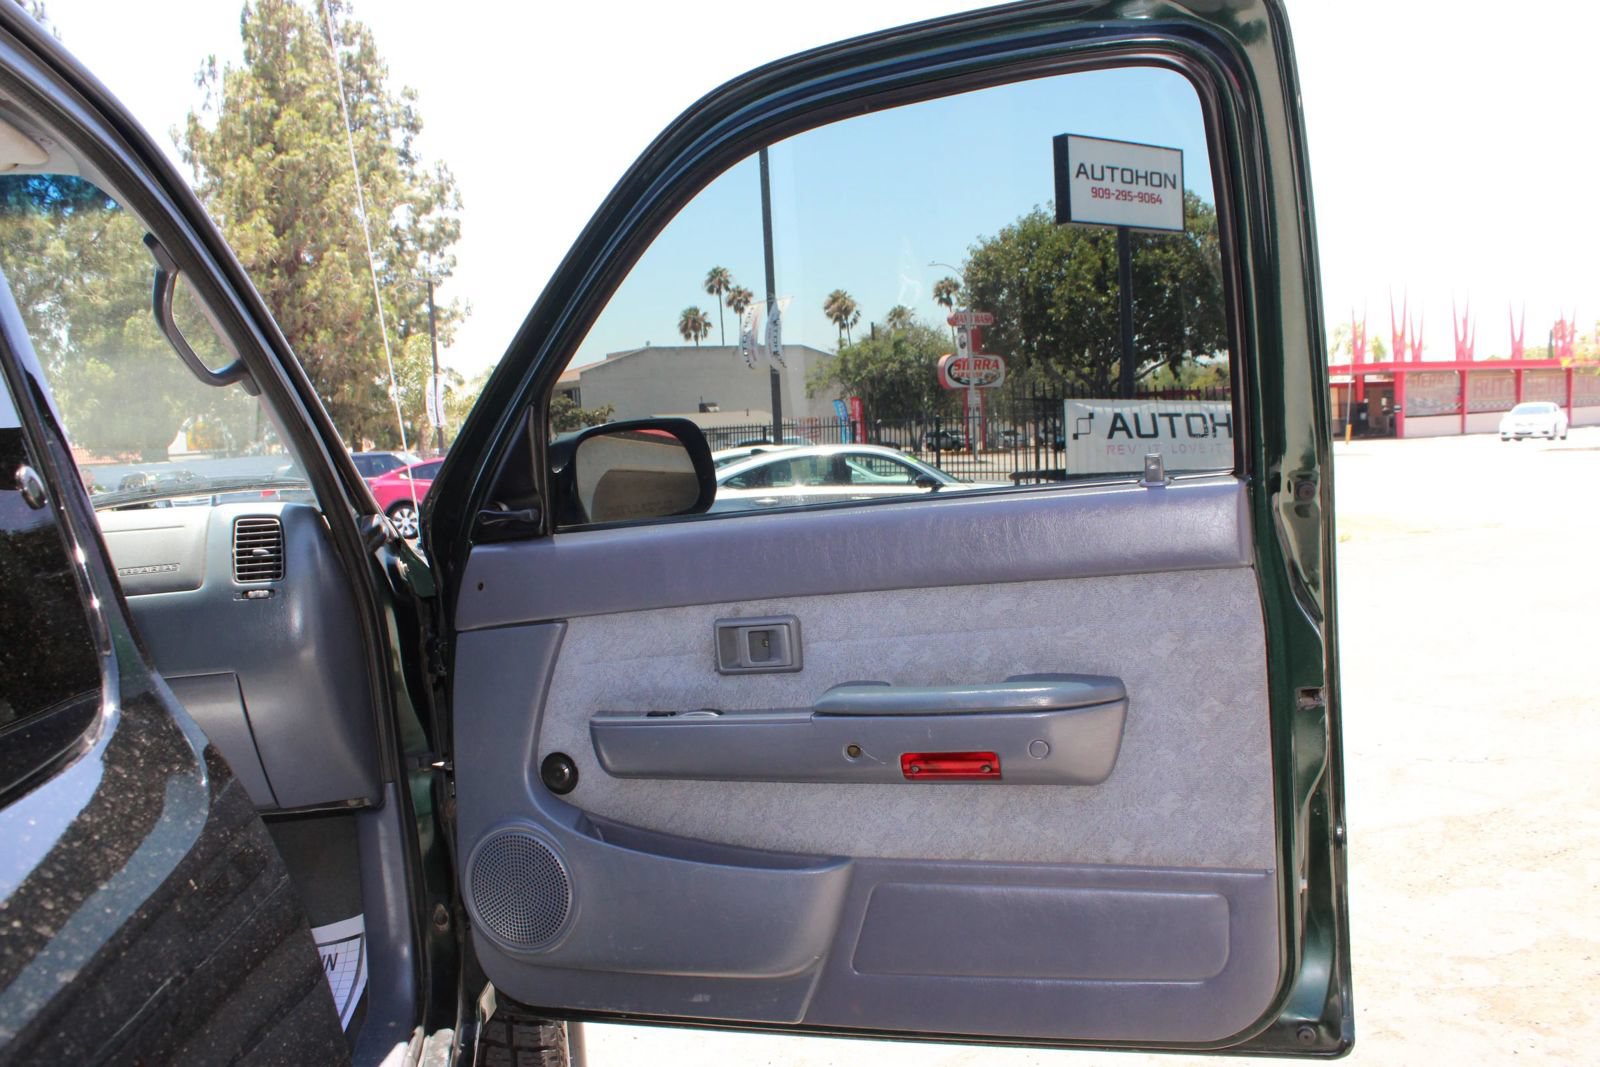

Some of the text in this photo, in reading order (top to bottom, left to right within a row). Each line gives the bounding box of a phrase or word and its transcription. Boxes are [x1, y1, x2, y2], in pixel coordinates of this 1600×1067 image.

[1075, 162, 1177, 190] AUTOHON
[1091, 186, 1163, 205] 909-295-9064
[1171, 443, 1205, 455] LOVE
